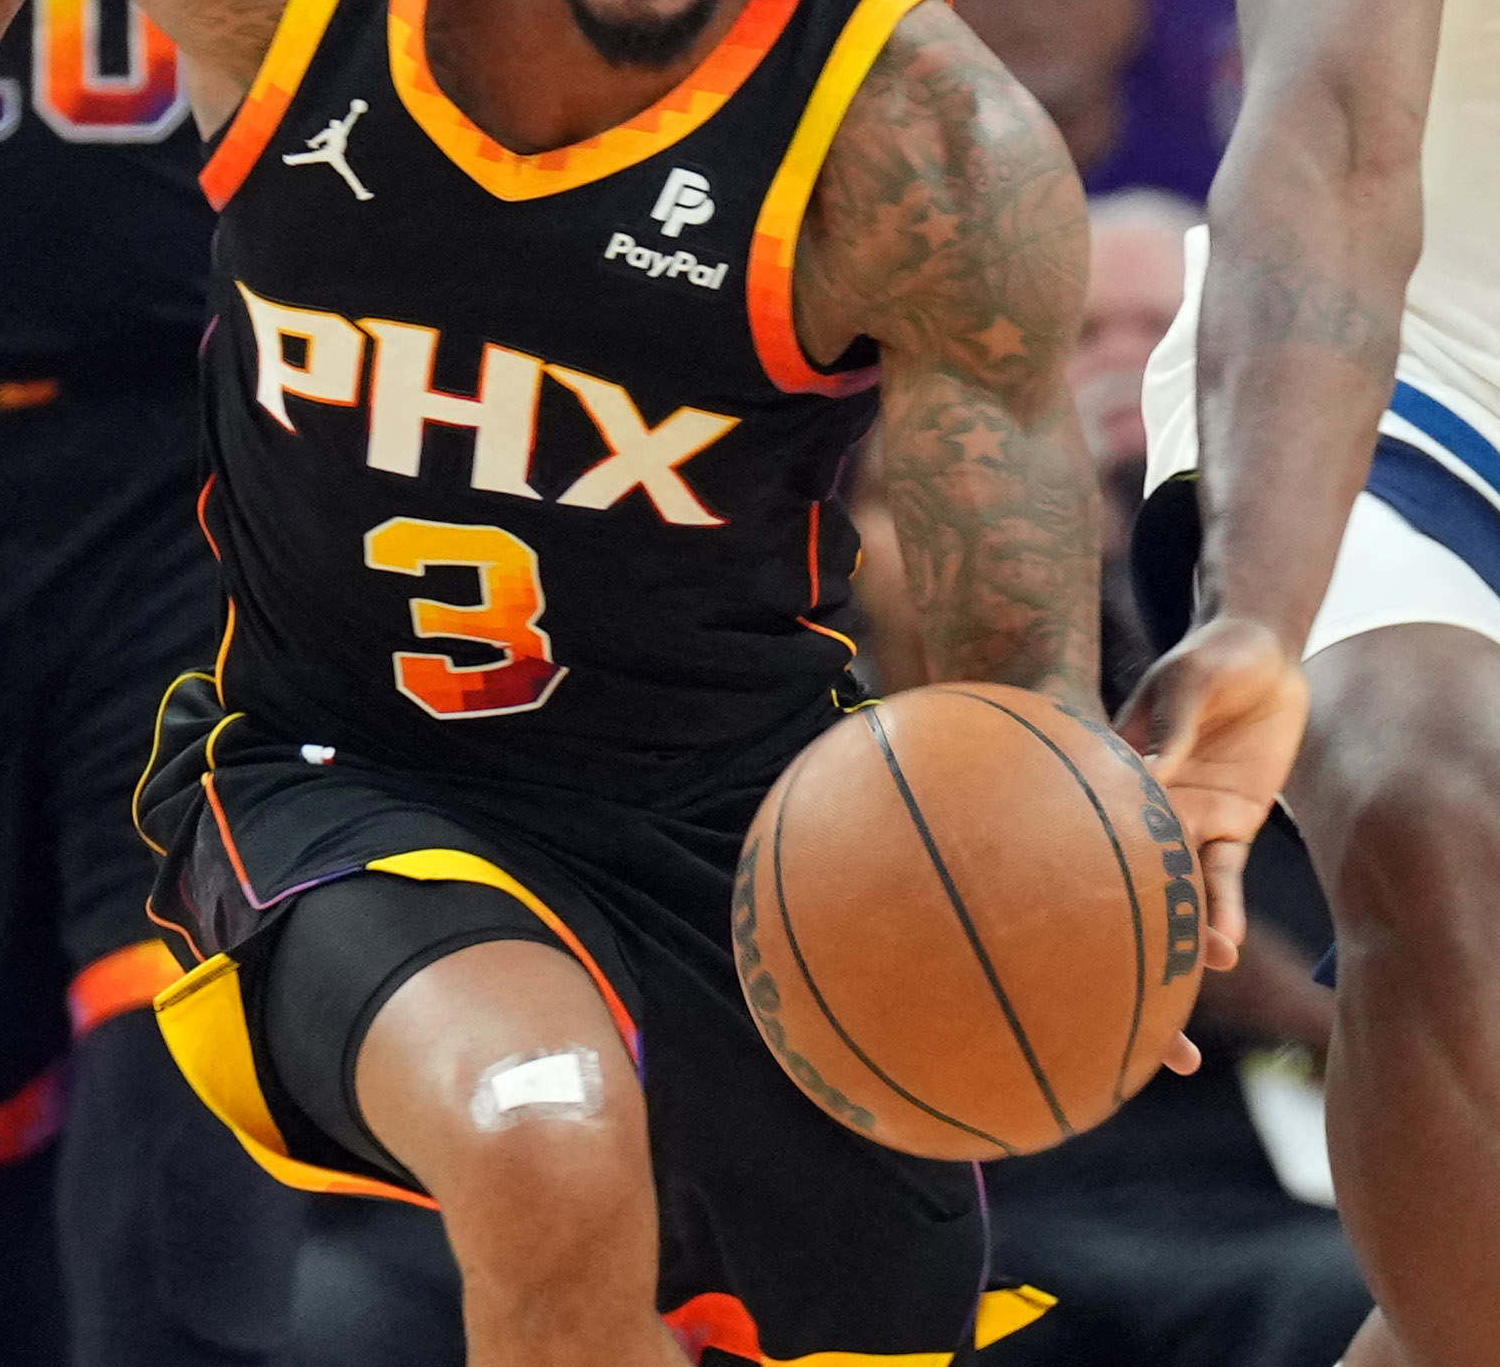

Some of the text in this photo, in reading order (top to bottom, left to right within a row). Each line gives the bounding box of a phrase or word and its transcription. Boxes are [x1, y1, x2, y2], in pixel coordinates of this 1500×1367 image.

[604, 232, 729, 291] PayPal
[234, 280, 742, 527] PHX
[363, 516, 570, 720] 3
